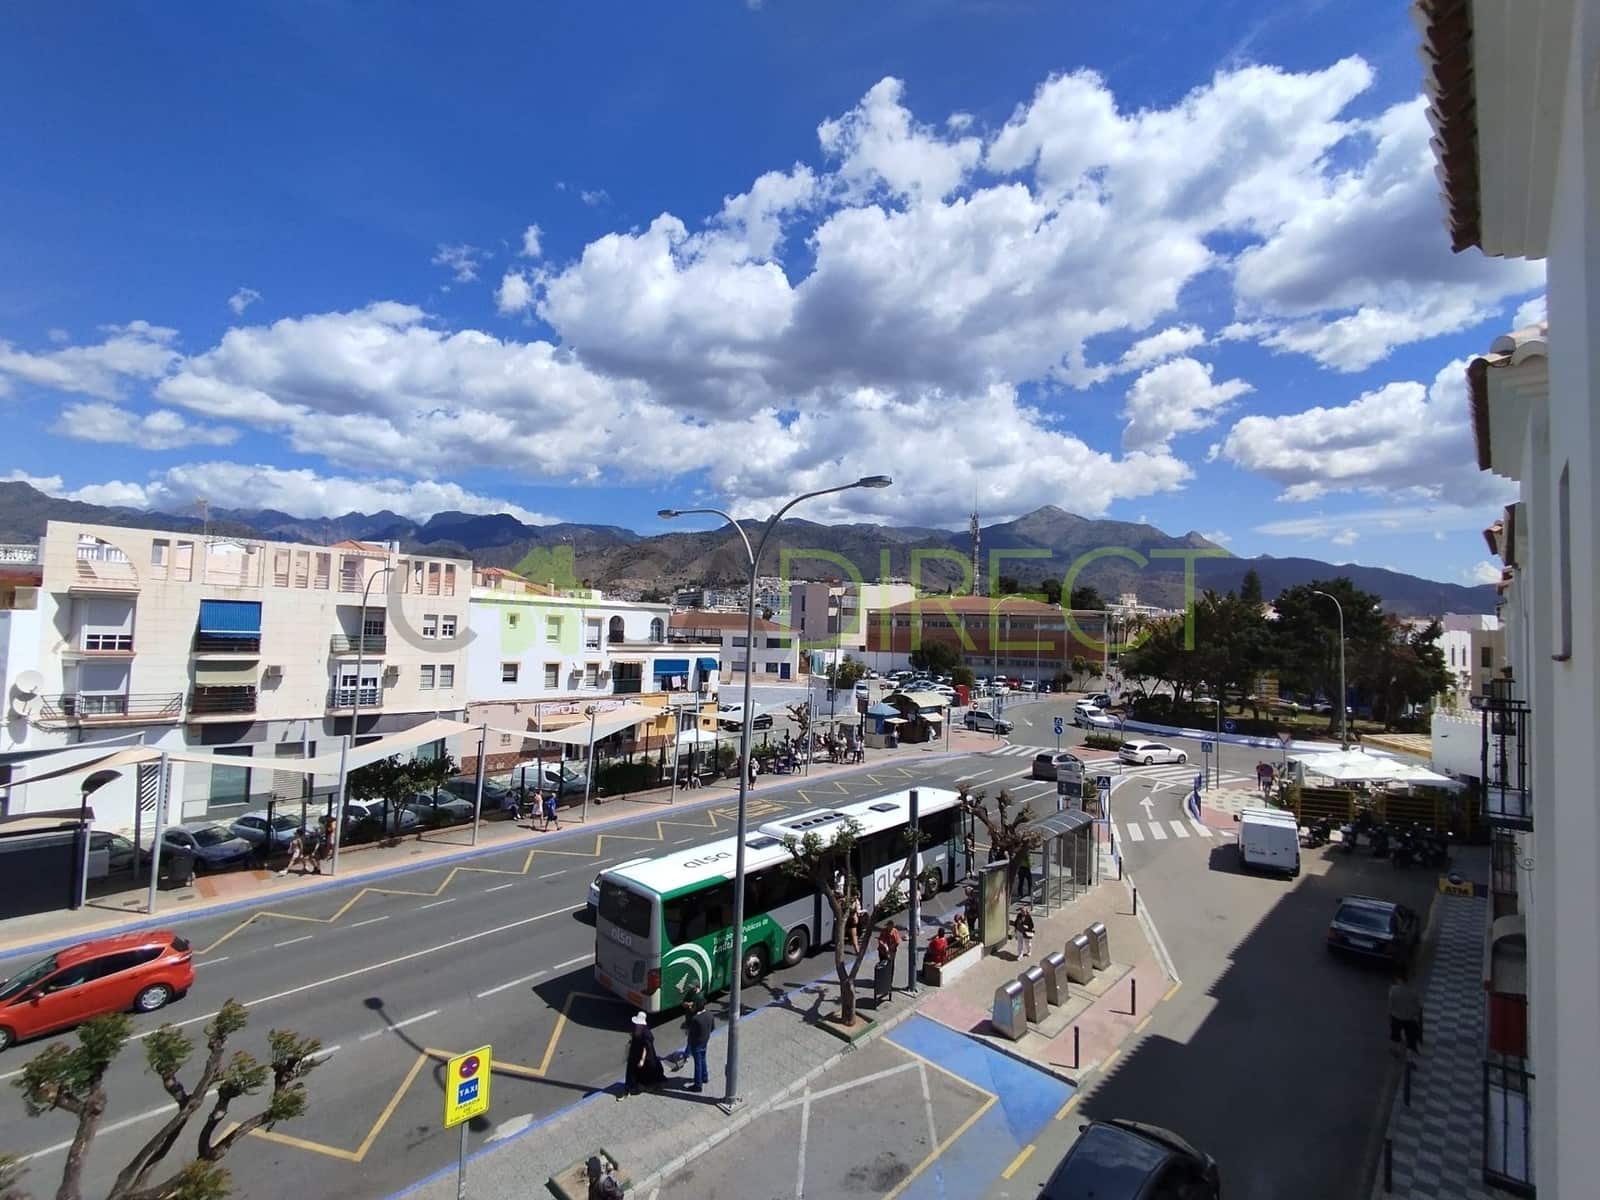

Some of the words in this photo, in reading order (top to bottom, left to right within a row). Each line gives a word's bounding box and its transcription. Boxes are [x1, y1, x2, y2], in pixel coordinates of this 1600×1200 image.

[683, 852, 732, 868] alsa
[611, 927, 632, 947] alsa
[459, 1084, 478, 1097] TAXI
